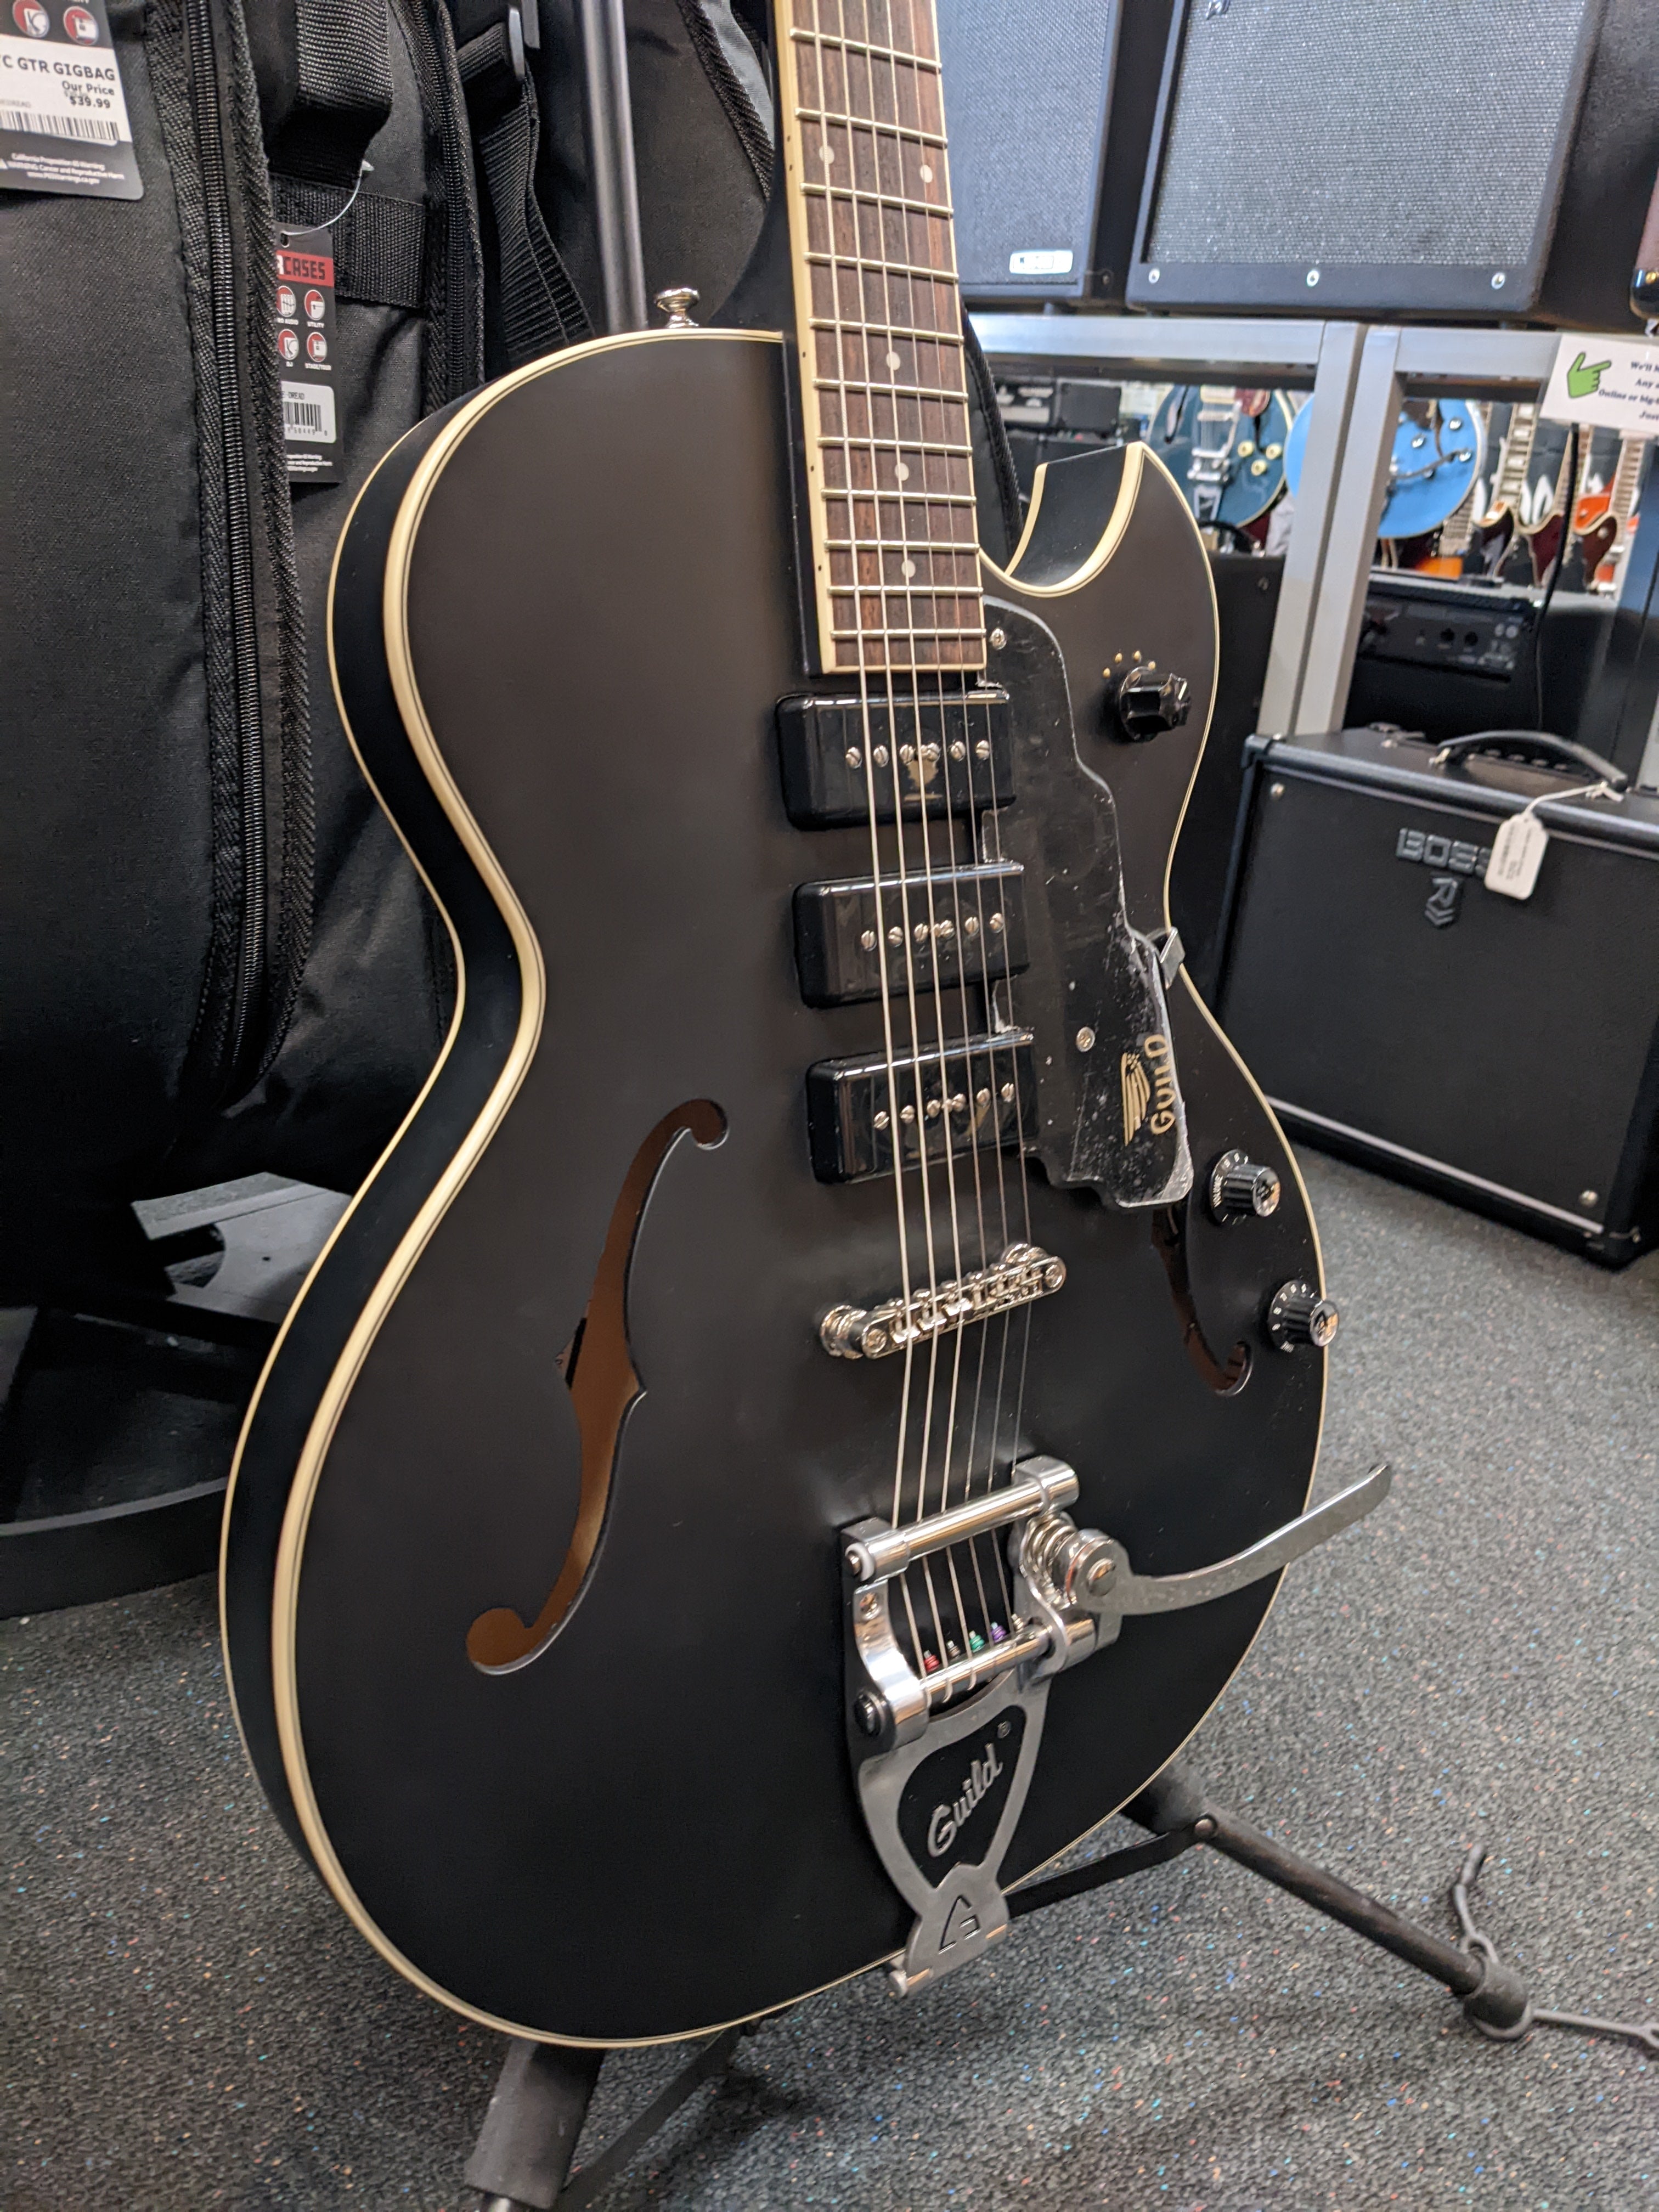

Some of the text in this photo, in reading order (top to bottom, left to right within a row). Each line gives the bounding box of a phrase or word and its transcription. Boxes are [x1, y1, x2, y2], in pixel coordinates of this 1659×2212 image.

[0, 55, 115, 81] C GTR GIGBAG
[62, 81, 82, 92] Our
[86, 83, 115, 95] Price
[70, 95, 110, 109] $39.99
[928, 1742, 1003, 1858] Guild
